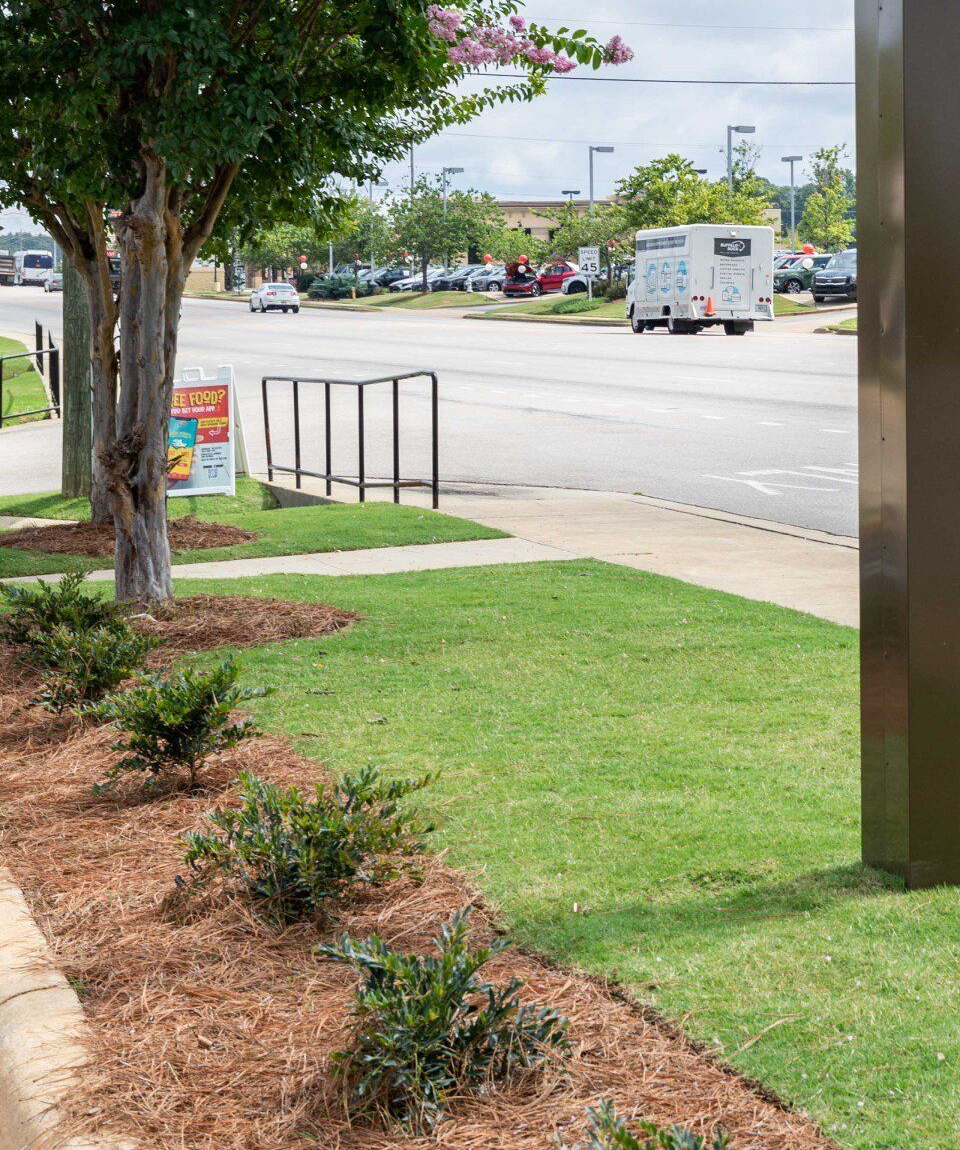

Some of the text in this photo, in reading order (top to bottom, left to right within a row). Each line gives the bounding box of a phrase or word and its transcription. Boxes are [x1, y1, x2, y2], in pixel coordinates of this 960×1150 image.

[581, 263, 598, 272] 45
[171, 389, 226, 407] EE FOOD?
